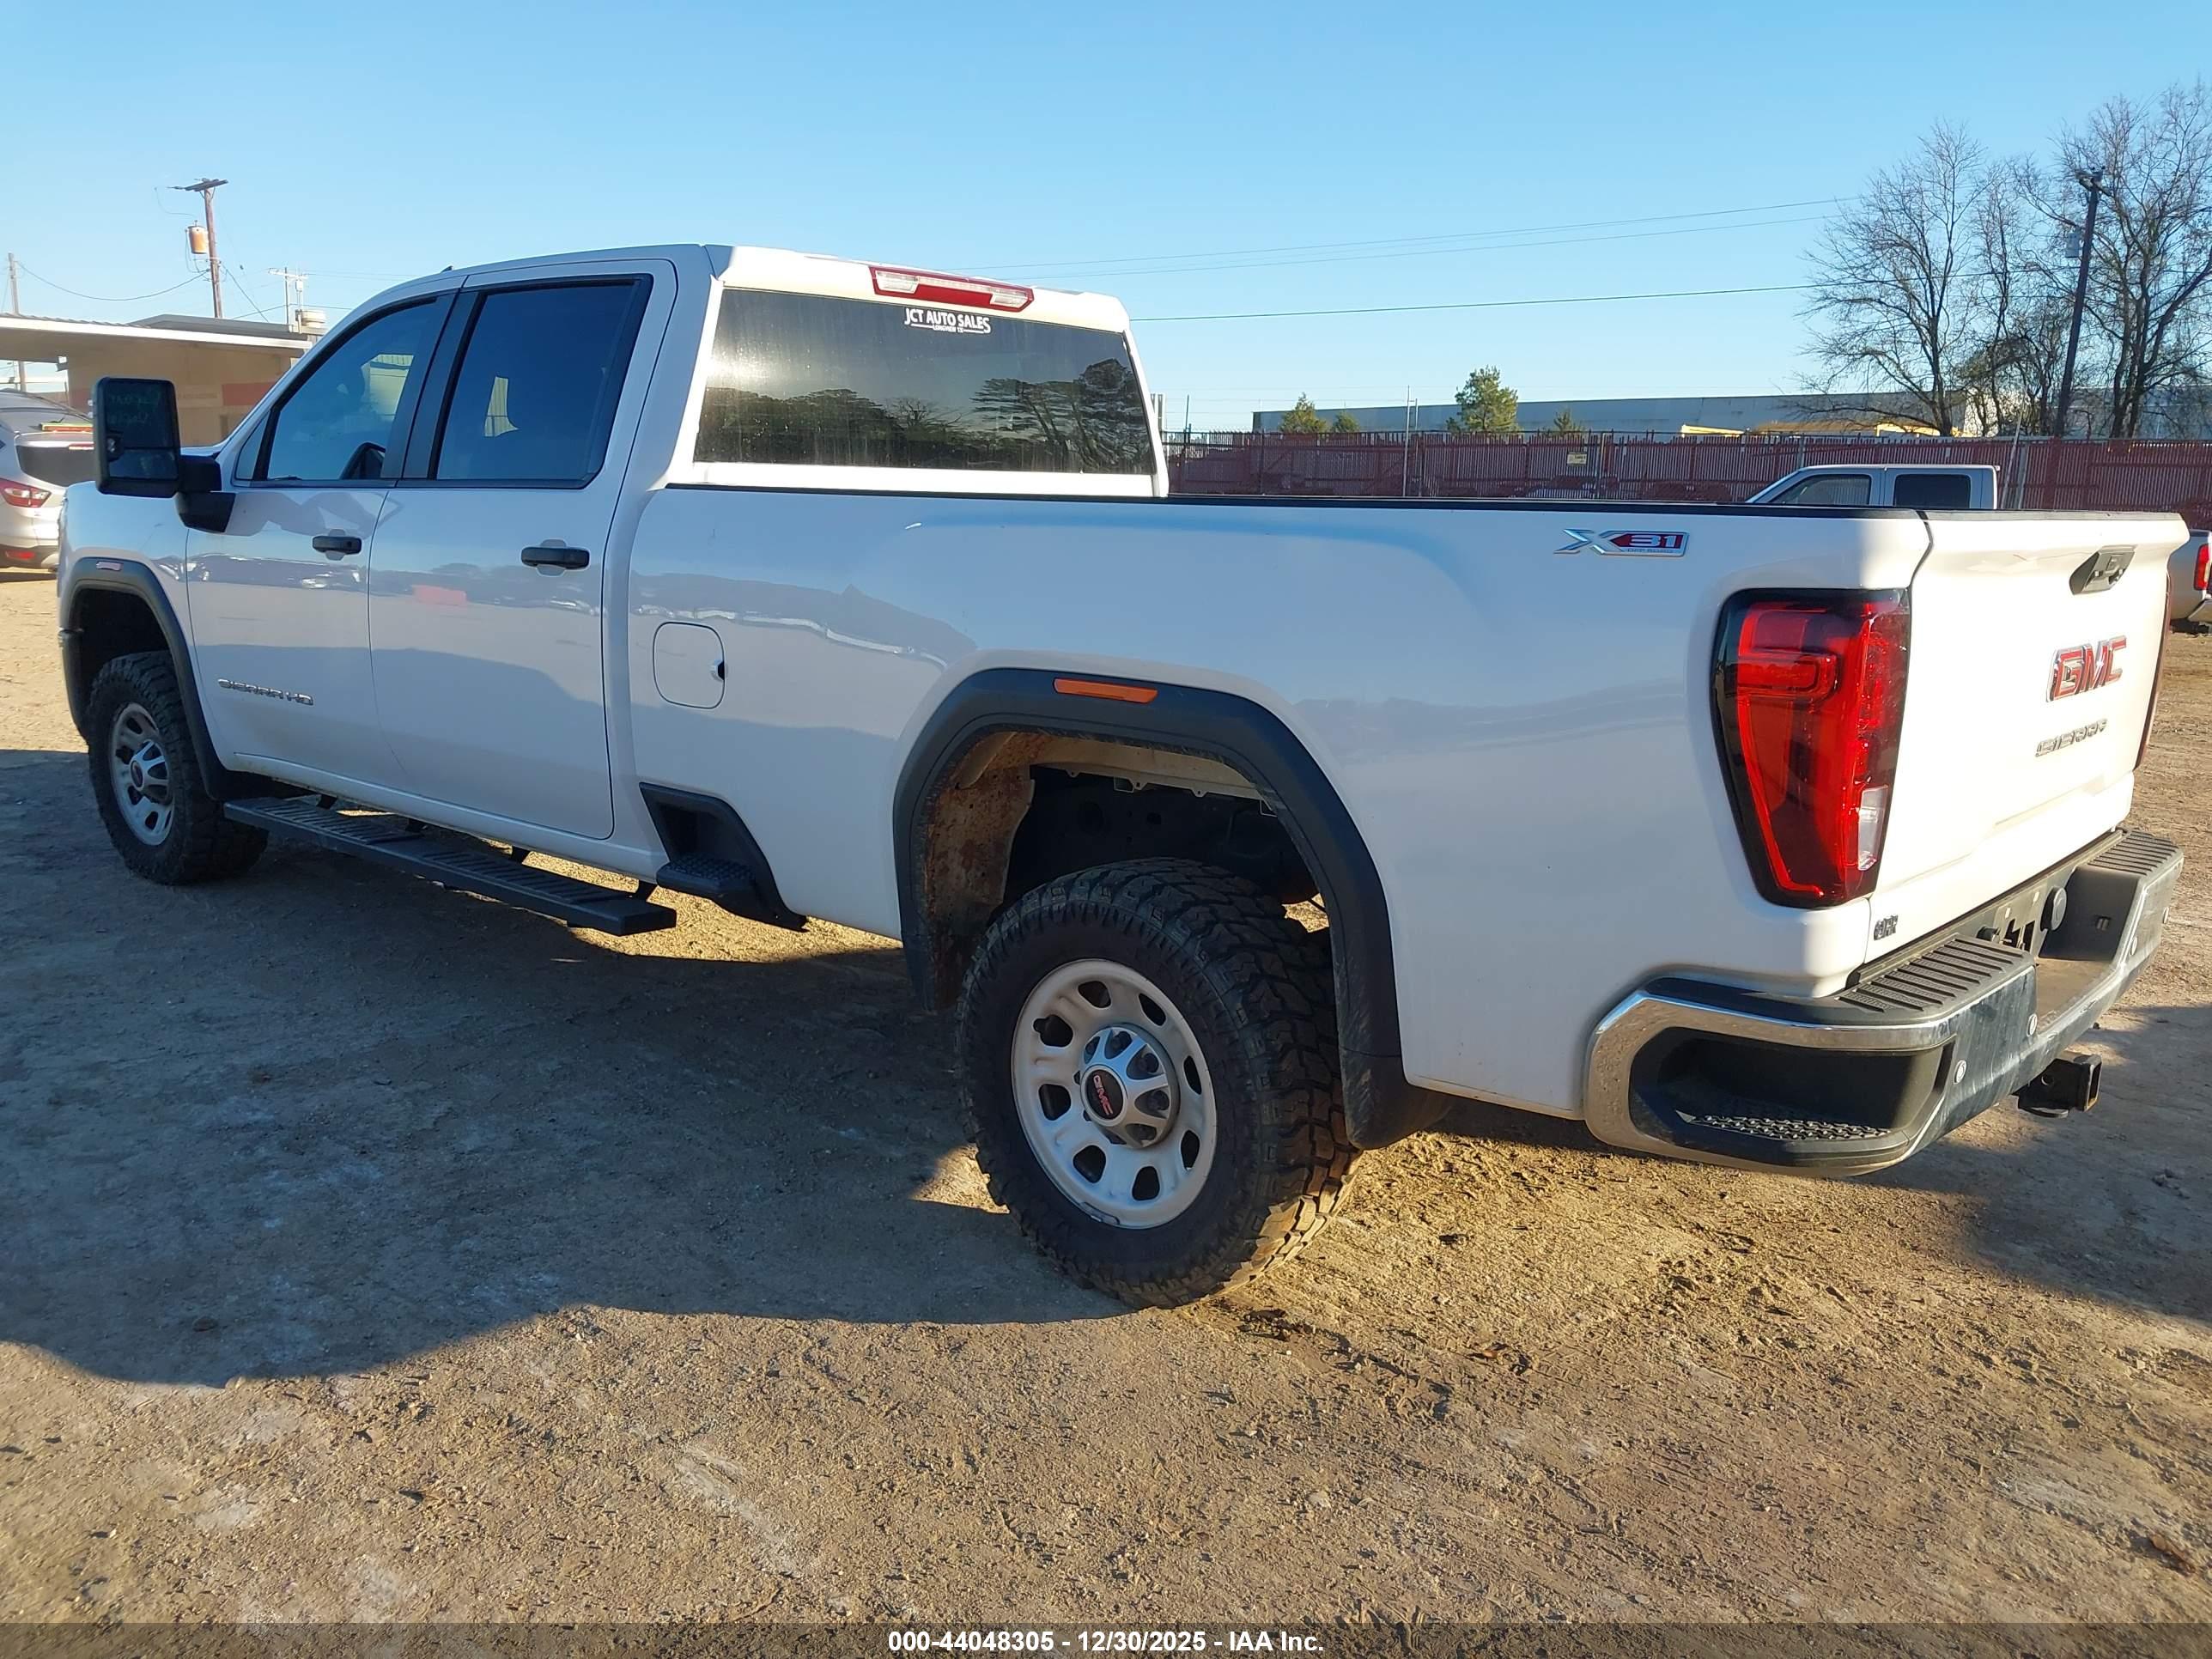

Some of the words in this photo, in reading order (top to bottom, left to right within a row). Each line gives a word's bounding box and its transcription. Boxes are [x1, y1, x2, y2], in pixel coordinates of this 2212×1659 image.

[904, 307, 924, 325] JCT
[927, 310, 957, 326] AUTO
[957, 313, 991, 333] SALES
[2045, 635, 2127, 703] GMC
[217, 677, 284, 699] SIERRA
[1092, 1073, 1114, 1116] GMC
